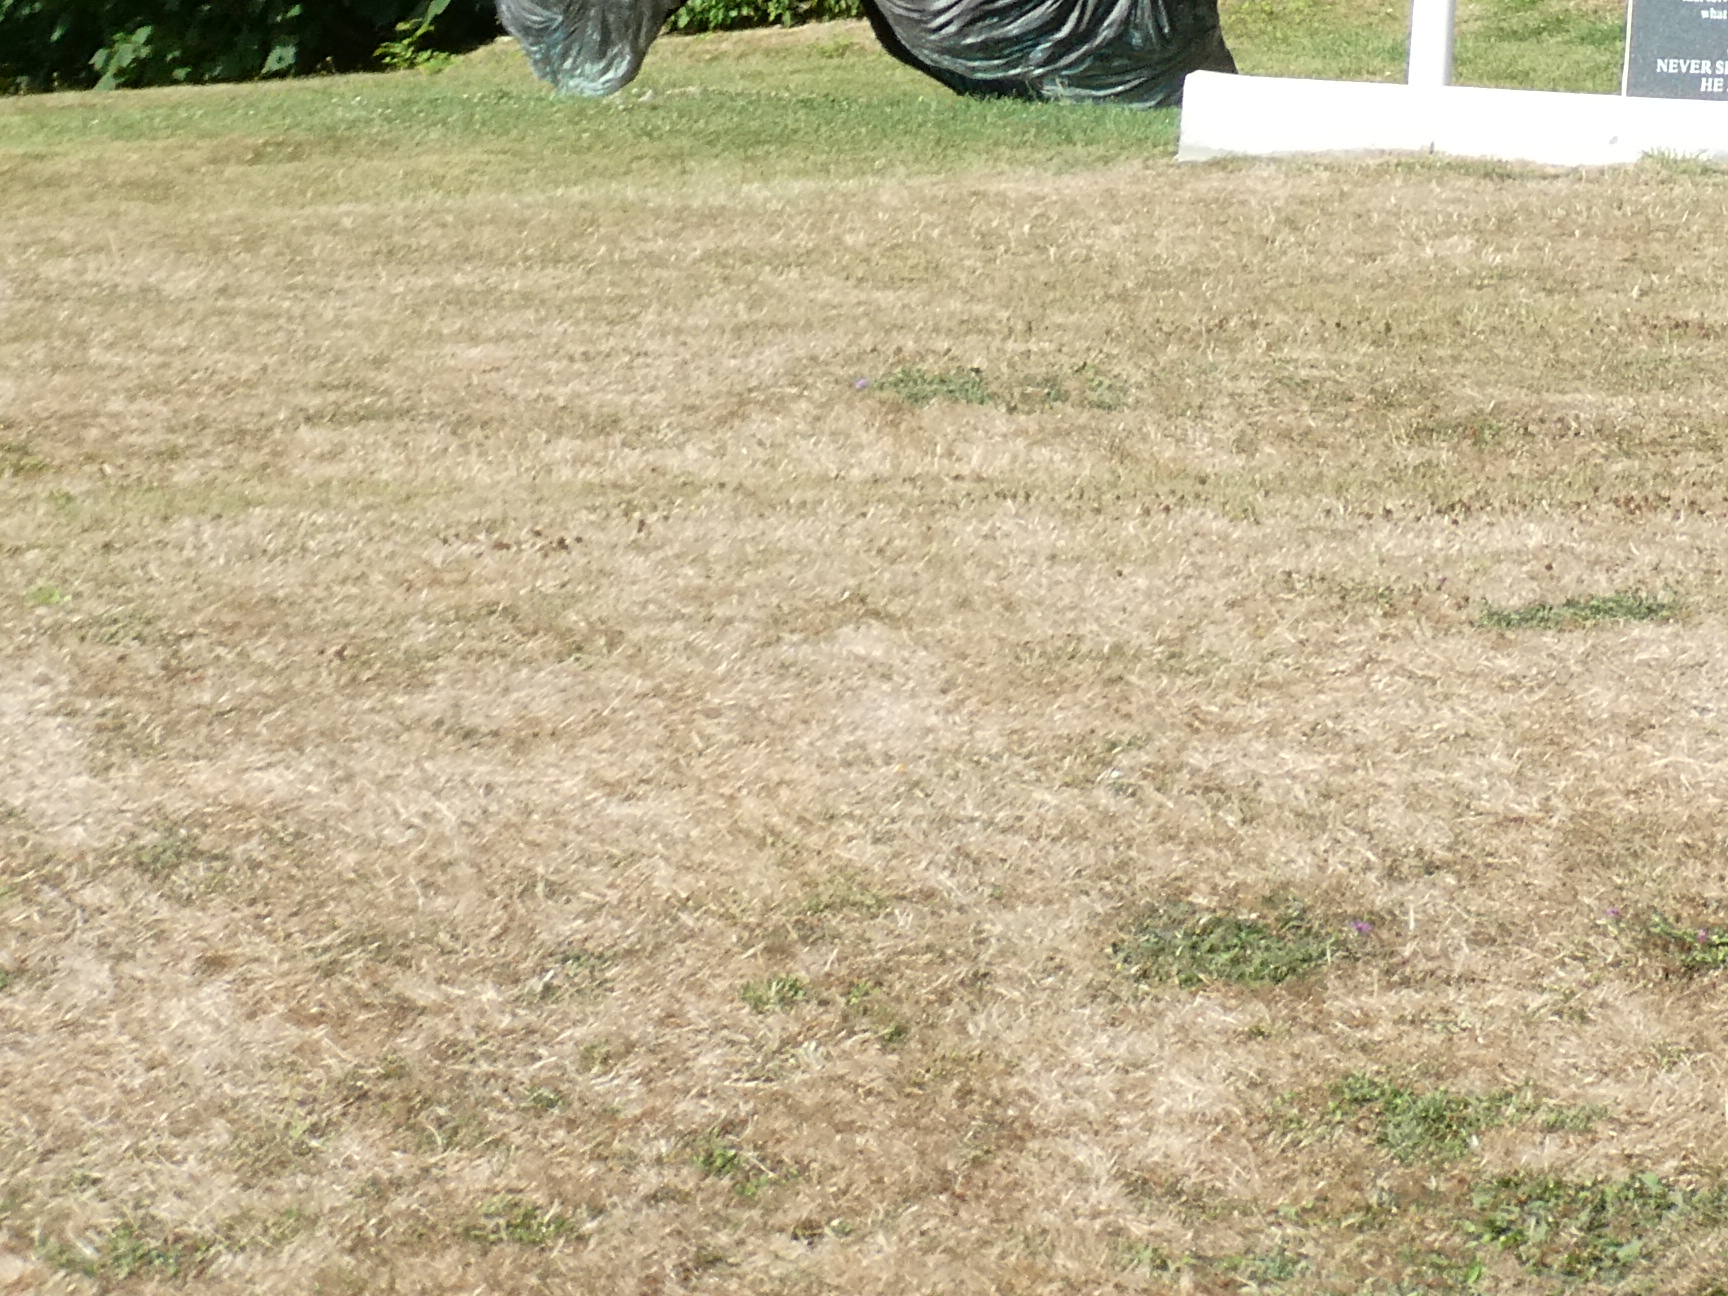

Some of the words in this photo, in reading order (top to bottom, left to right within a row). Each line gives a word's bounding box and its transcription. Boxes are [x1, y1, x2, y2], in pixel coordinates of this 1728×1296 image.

[1701, 7, 1726, 20] what
[1656, 58, 1711, 75] NEVER
[1700, 76, 1722, 93] HE
